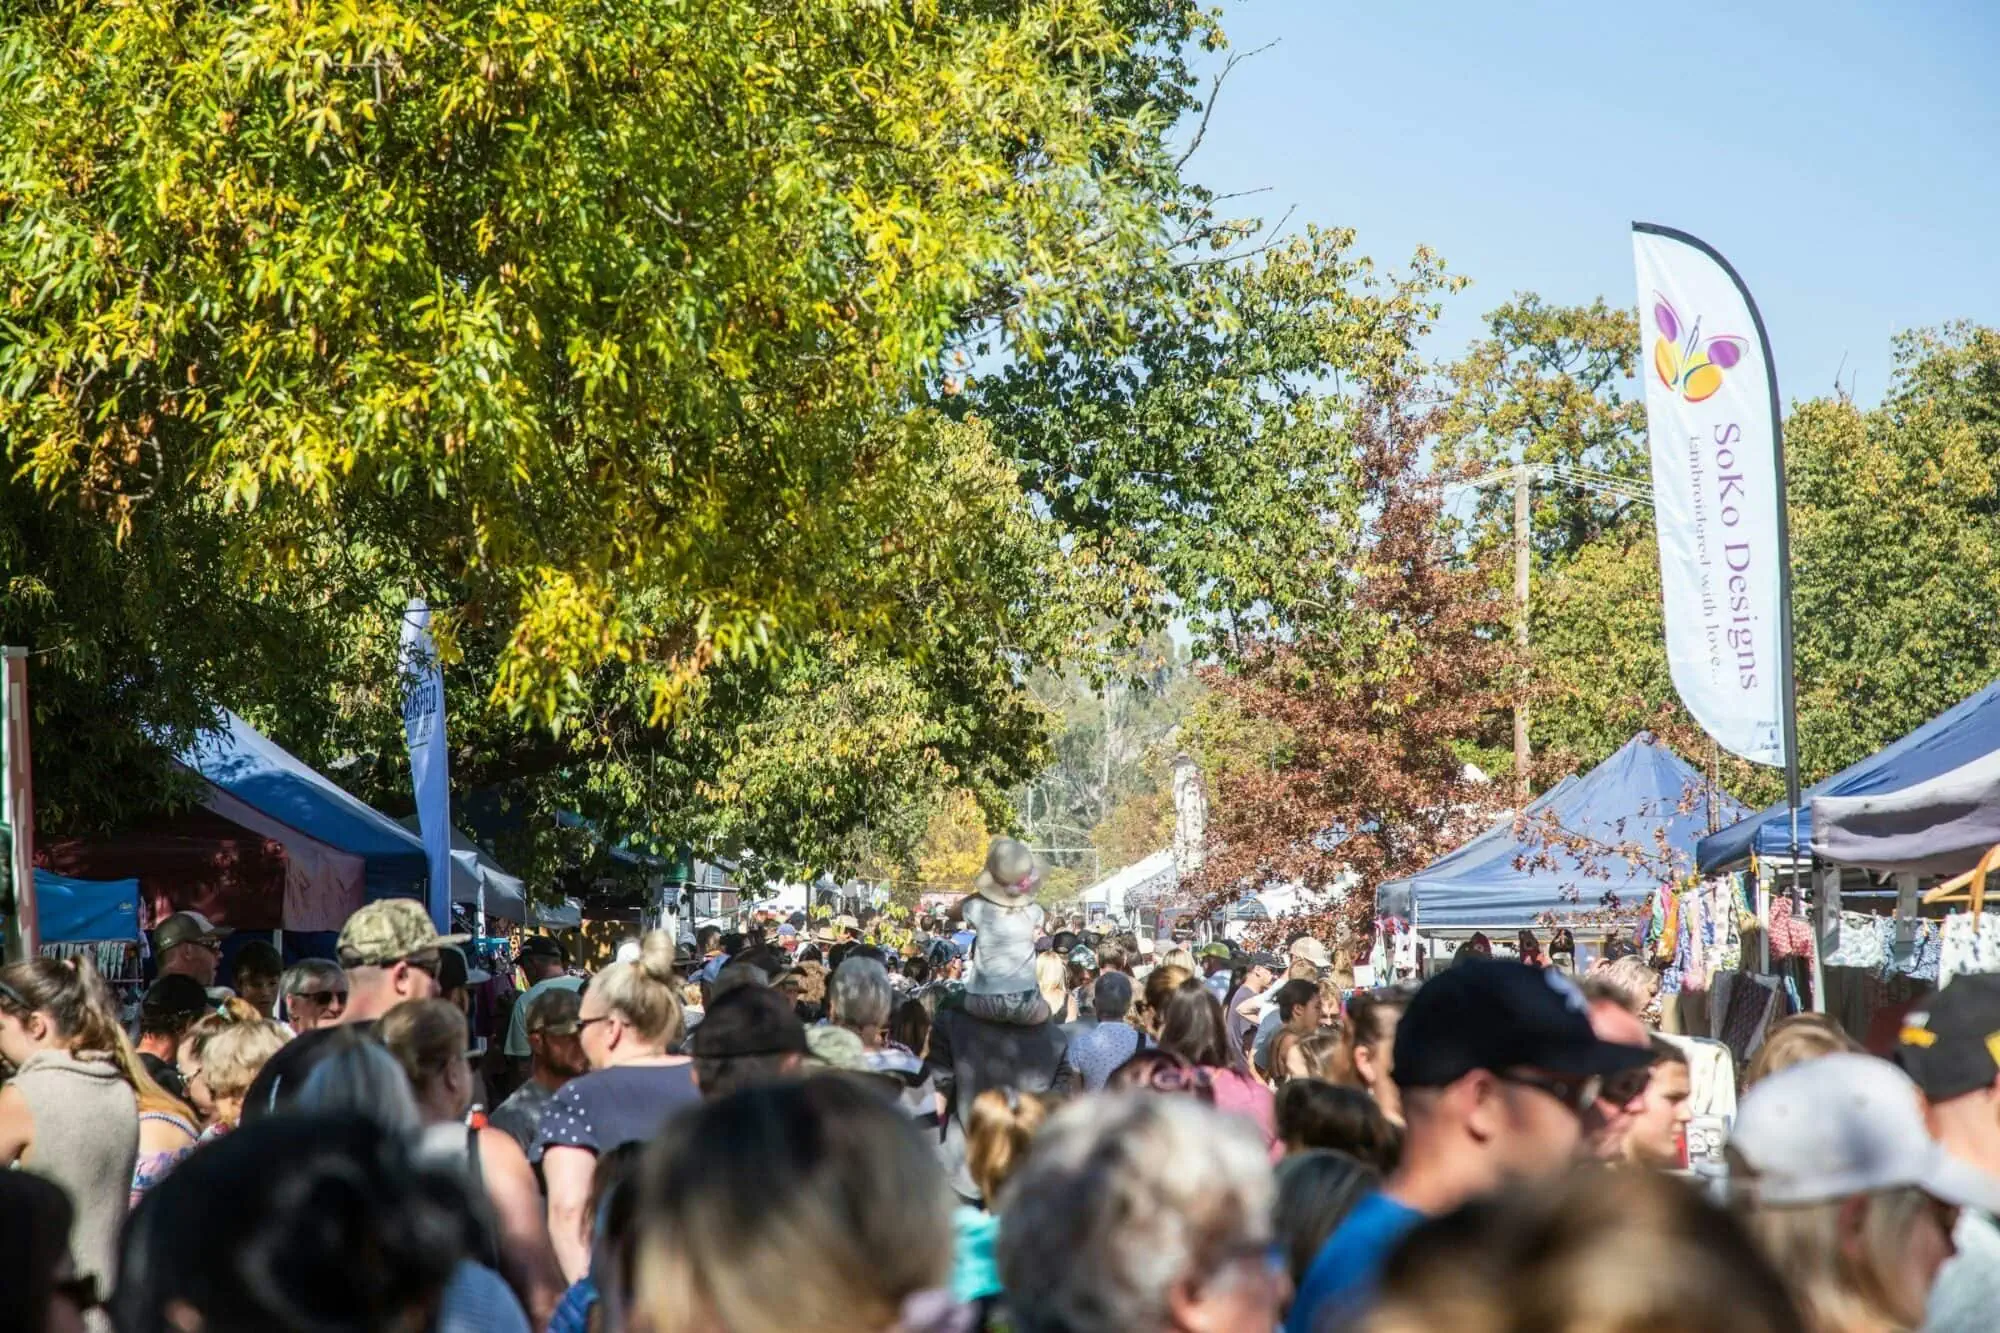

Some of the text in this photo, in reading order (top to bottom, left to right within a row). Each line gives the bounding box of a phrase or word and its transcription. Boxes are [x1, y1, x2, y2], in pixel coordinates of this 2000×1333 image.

[1689, 435, 1712, 567] Embroidered
[1701, 573, 1718, 617] with
[1713, 423, 1758, 691] SoKo Designs
